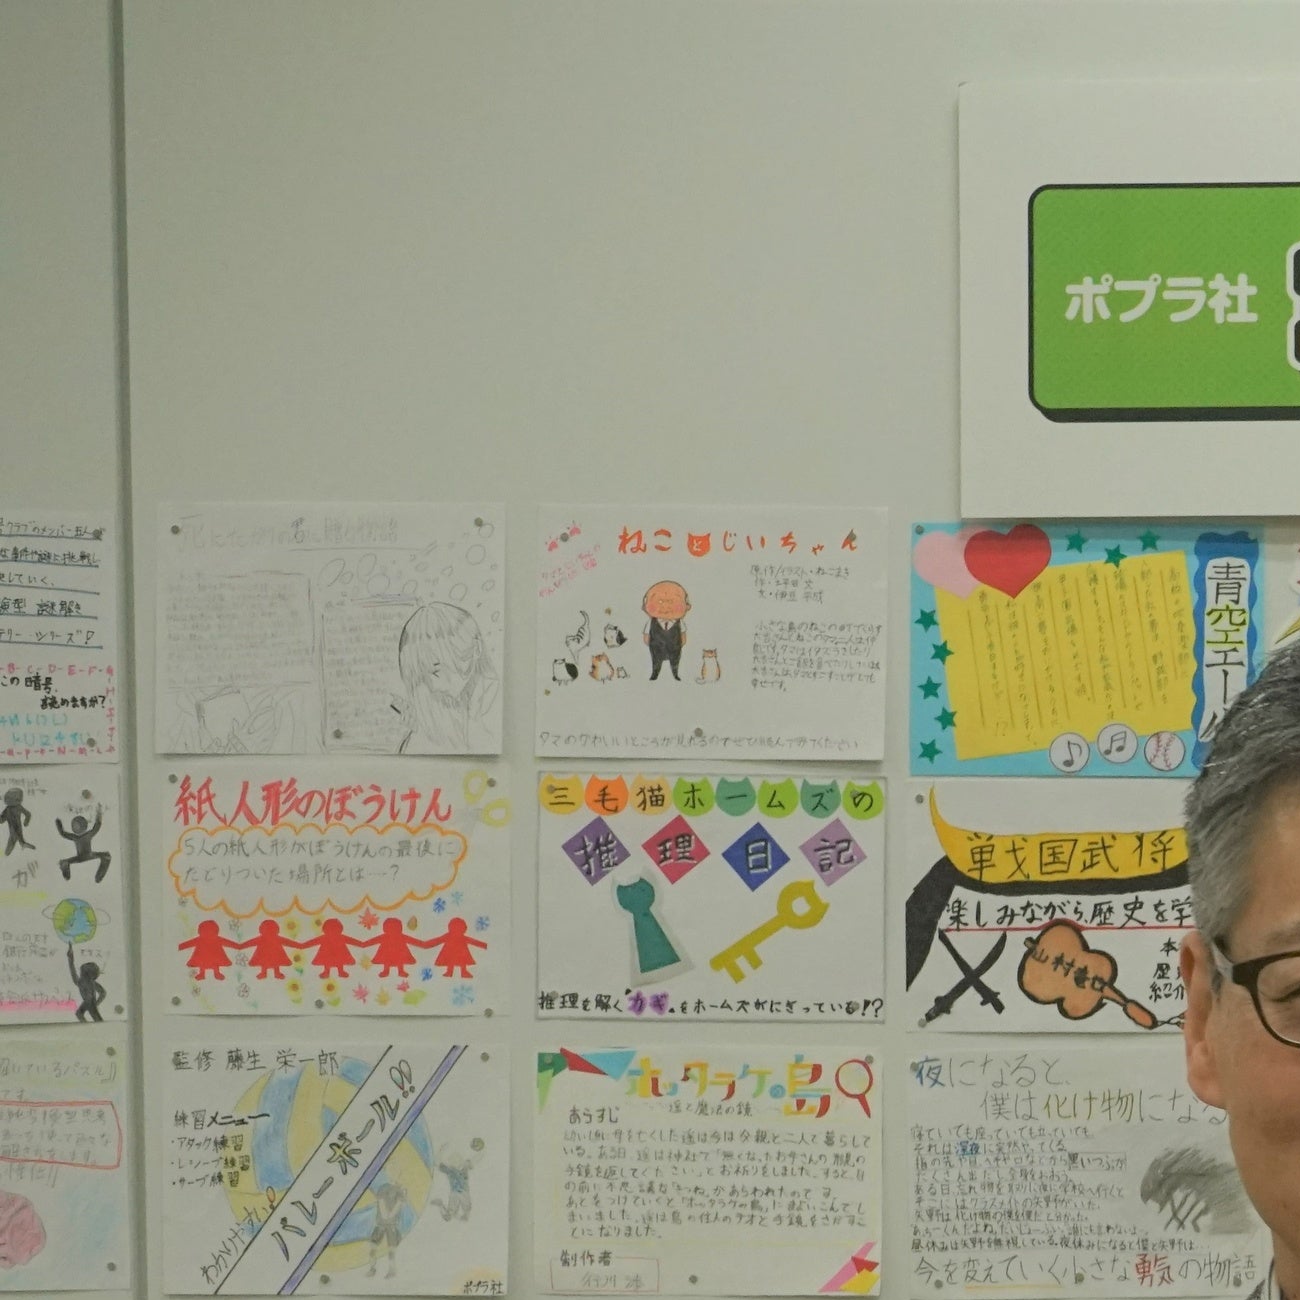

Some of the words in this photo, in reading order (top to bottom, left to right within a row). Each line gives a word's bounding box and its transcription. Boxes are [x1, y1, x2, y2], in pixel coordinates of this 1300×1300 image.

[1062, 270, 1259, 328] ポプラ社
[173, 773, 454, 827] 紙人形のぼうけん
[549, 781, 876, 814] 三毛猫ホームズの
[574, 824, 858, 878] 推理日記
[966, 831, 1176, 882] 戦国武将
[172, 1049, 215, 1074] 監修
[915, 1053, 1071, 1088] 夜になると、
[173, 1107, 273, 1130] 練習メニュー
[568, 1104, 620, 1125] あらすじ
[980, 1087, 1229, 1126] 僕は化け物になる
[462, 1277, 505, 1297] ポプラ社
[913, 1250, 1258, 1288] 今を変えていく小さな勇気の物語
